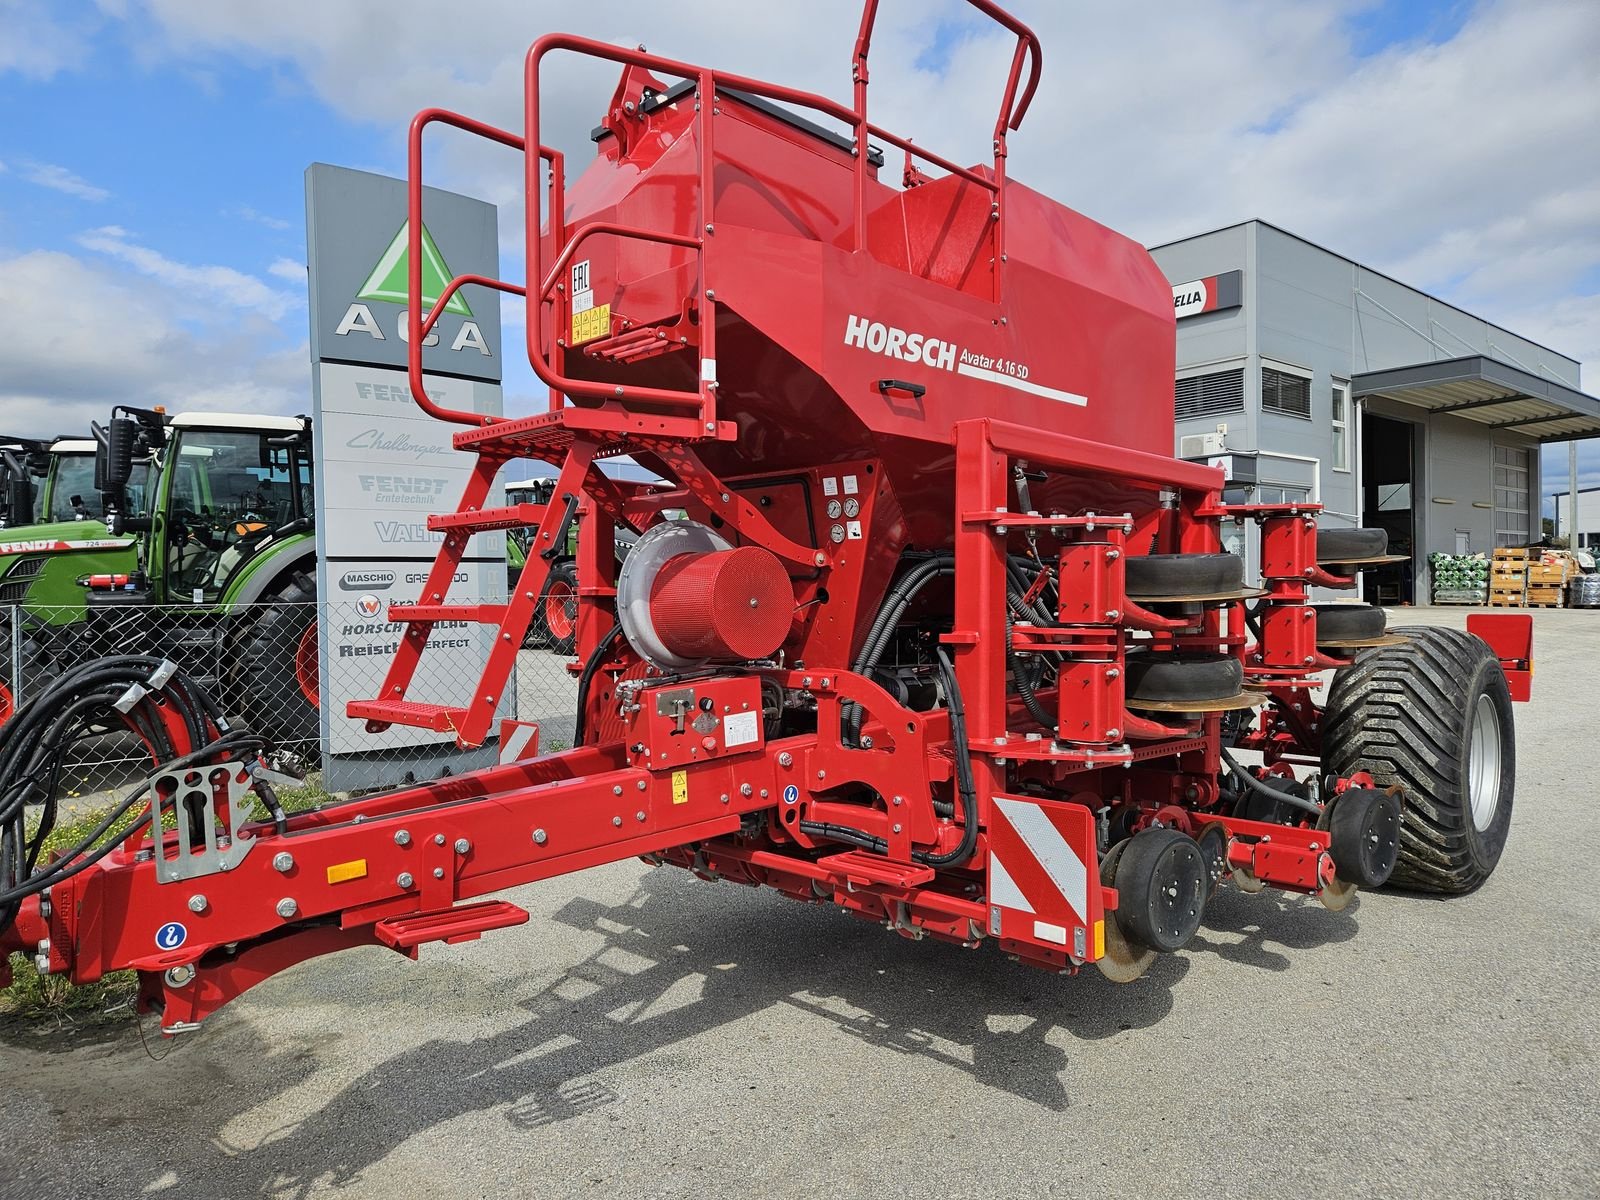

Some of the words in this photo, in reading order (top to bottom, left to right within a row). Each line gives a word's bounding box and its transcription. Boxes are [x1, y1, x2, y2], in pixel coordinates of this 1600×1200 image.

[1173, 291, 1202, 308] ELLA
[844, 314, 957, 371] HORSCH
[960, 348, 995, 370] Avatar
[996, 358, 1016, 376] 4.16
[1016, 364, 1029, 379] SD
[346, 429, 457, 460] Challenger
[358, 475, 448, 494] FENDT
[375, 493, 435, 504] Erntetechnik
[1, 539, 58, 552] FENDT
[347, 573, 394, 582] MASCHIO
[342, 623, 402, 635] HORSCH
[426, 639, 469, 649] ERFECT
